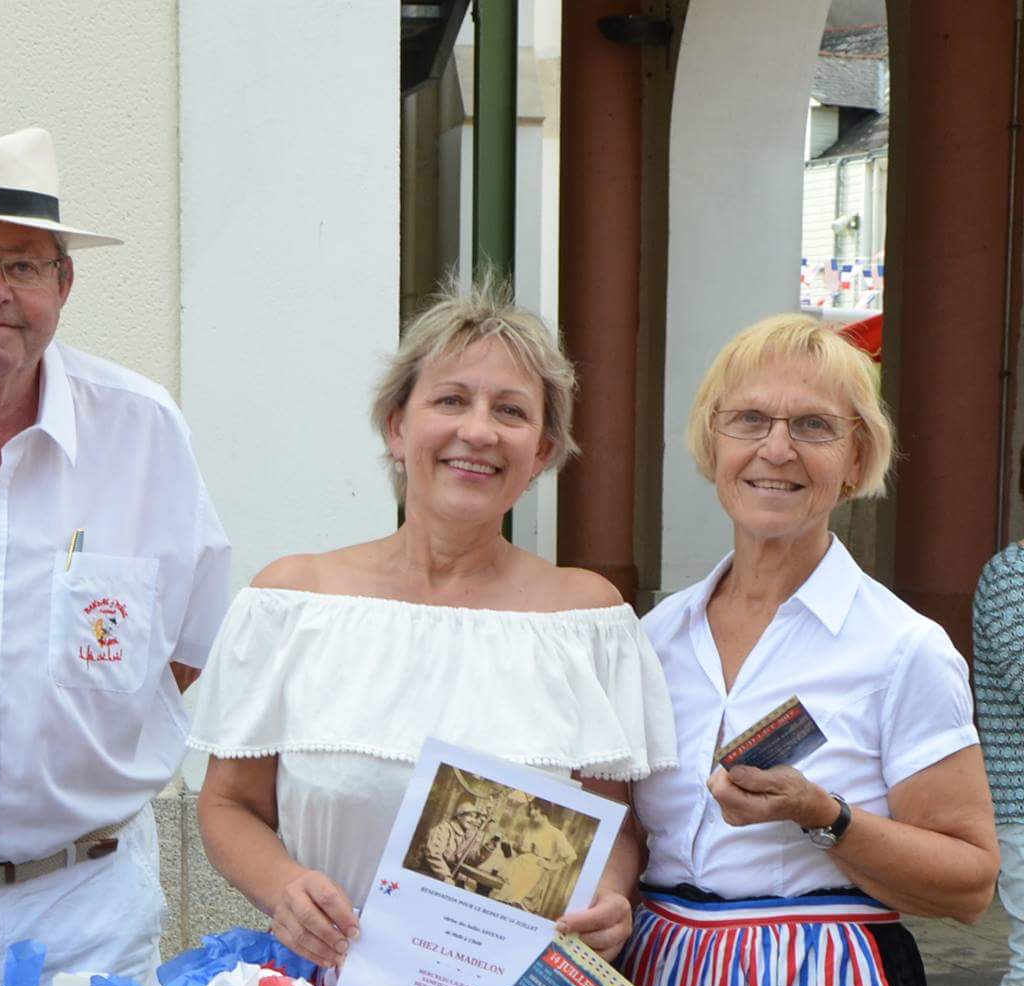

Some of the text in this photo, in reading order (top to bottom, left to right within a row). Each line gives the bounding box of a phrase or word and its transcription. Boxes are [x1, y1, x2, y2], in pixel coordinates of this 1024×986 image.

[412, 937, 439, 953] CHEZ
[440, 946, 453, 958] LA
[454, 952, 505, 975] MADELON
